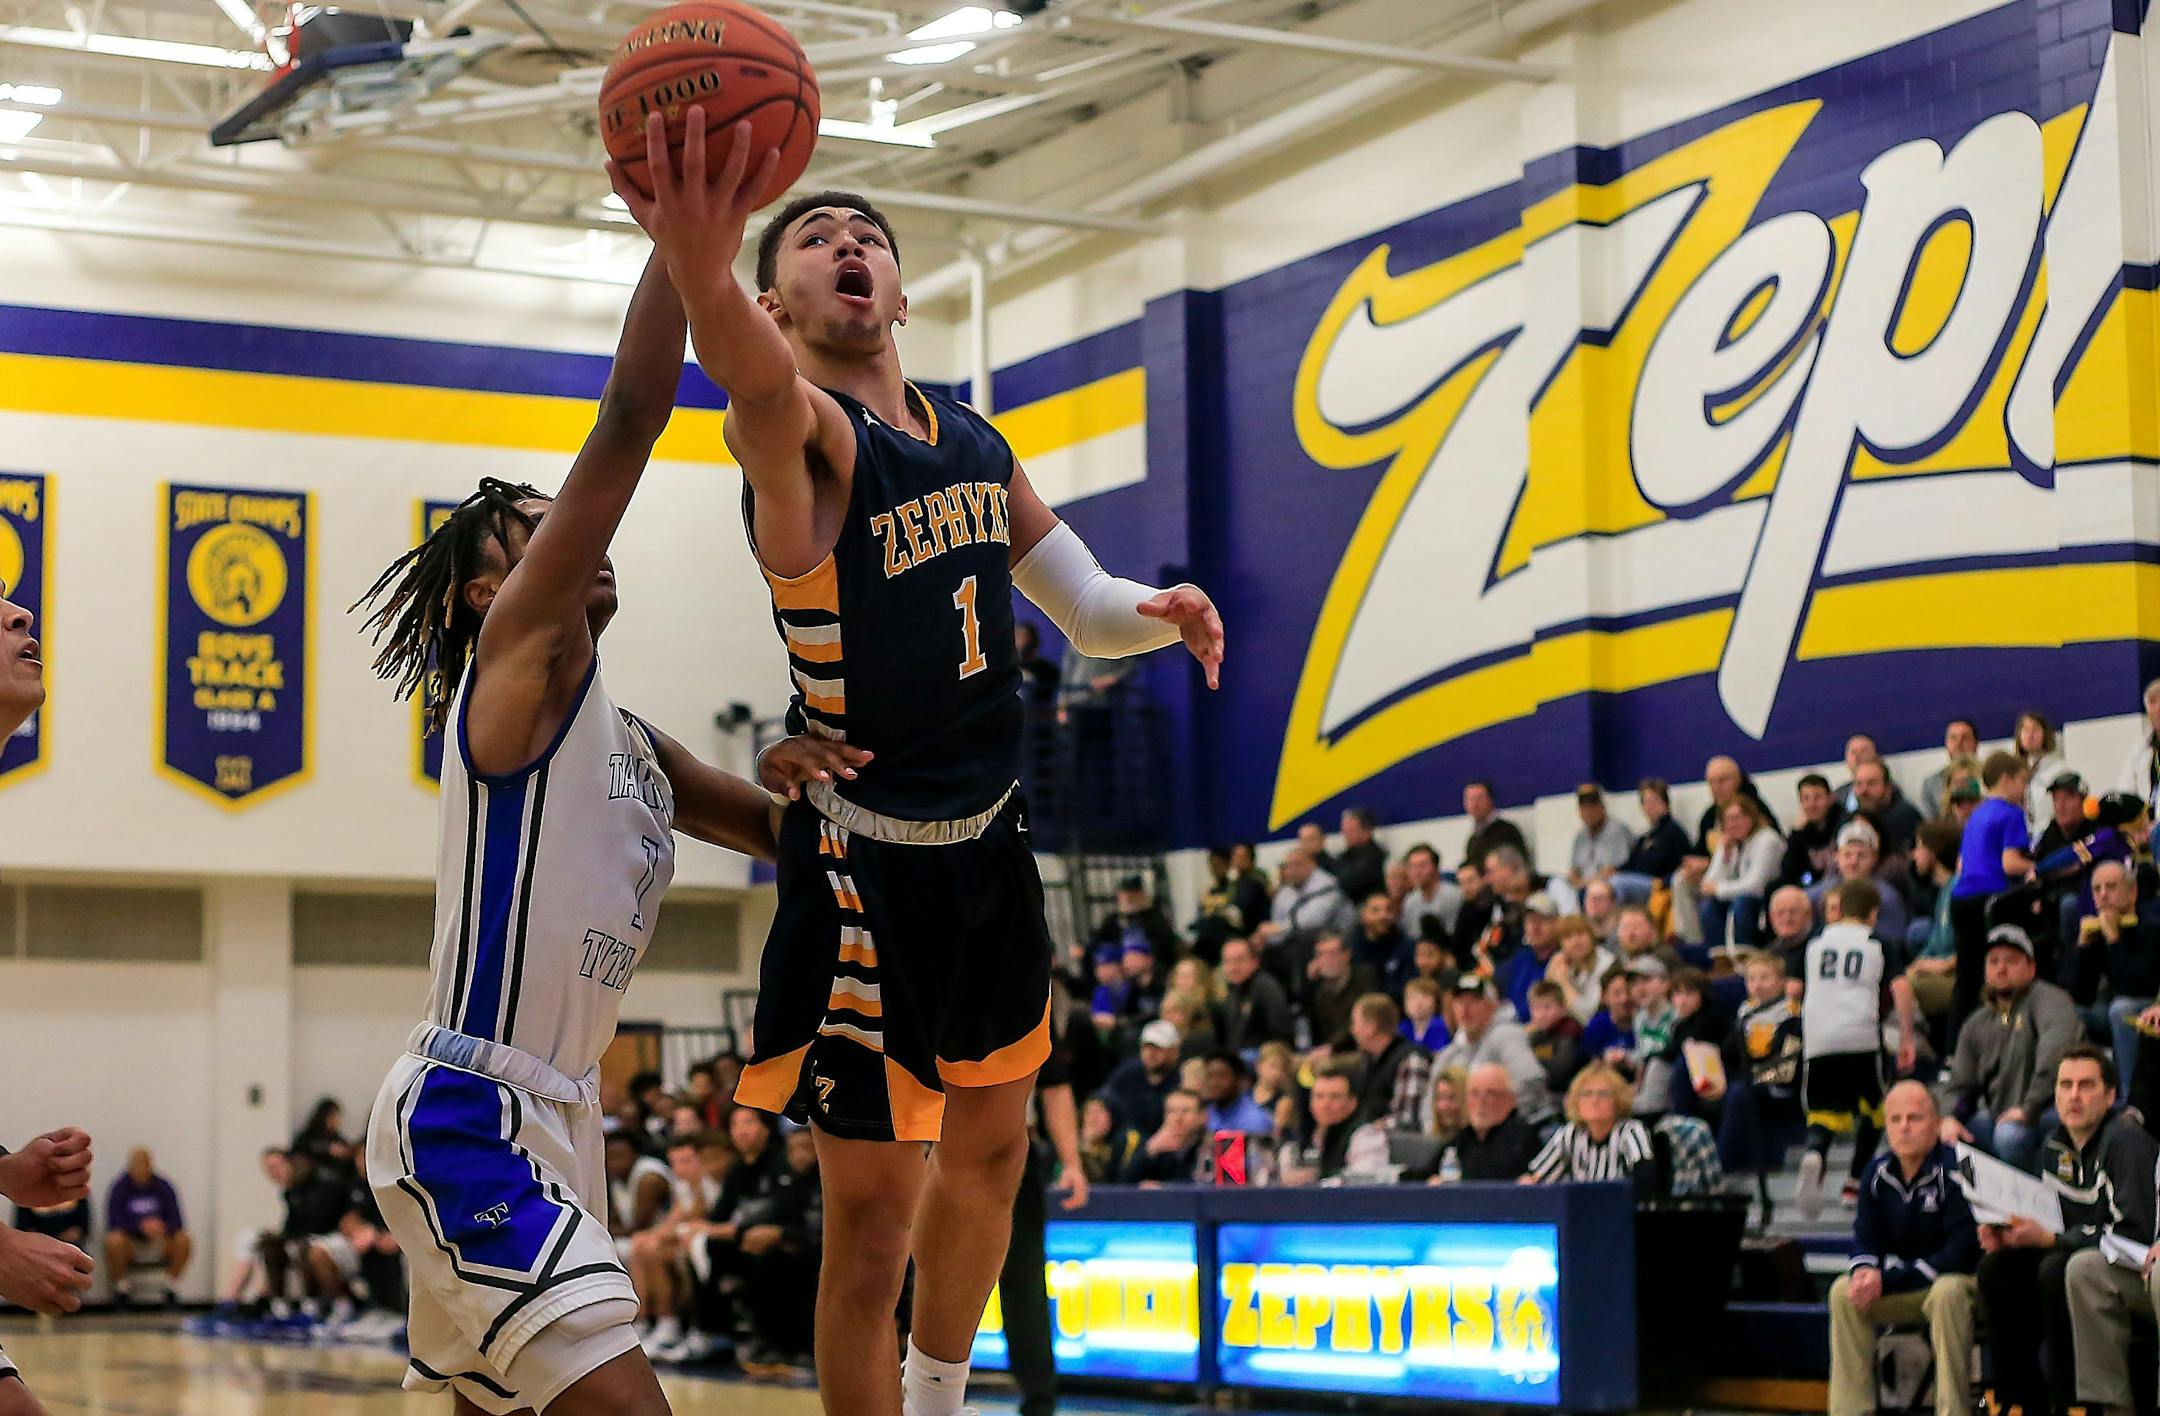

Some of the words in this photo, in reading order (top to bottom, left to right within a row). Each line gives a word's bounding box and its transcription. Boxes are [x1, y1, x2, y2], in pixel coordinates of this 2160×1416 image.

[952, 574, 988, 680] 1
[186, 657, 284, 689] TRACK
[578, 928, 637, 995] TITA
[1820, 949, 1863, 979] 20
[1222, 1262, 1495, 1355] ZEPHYRS
